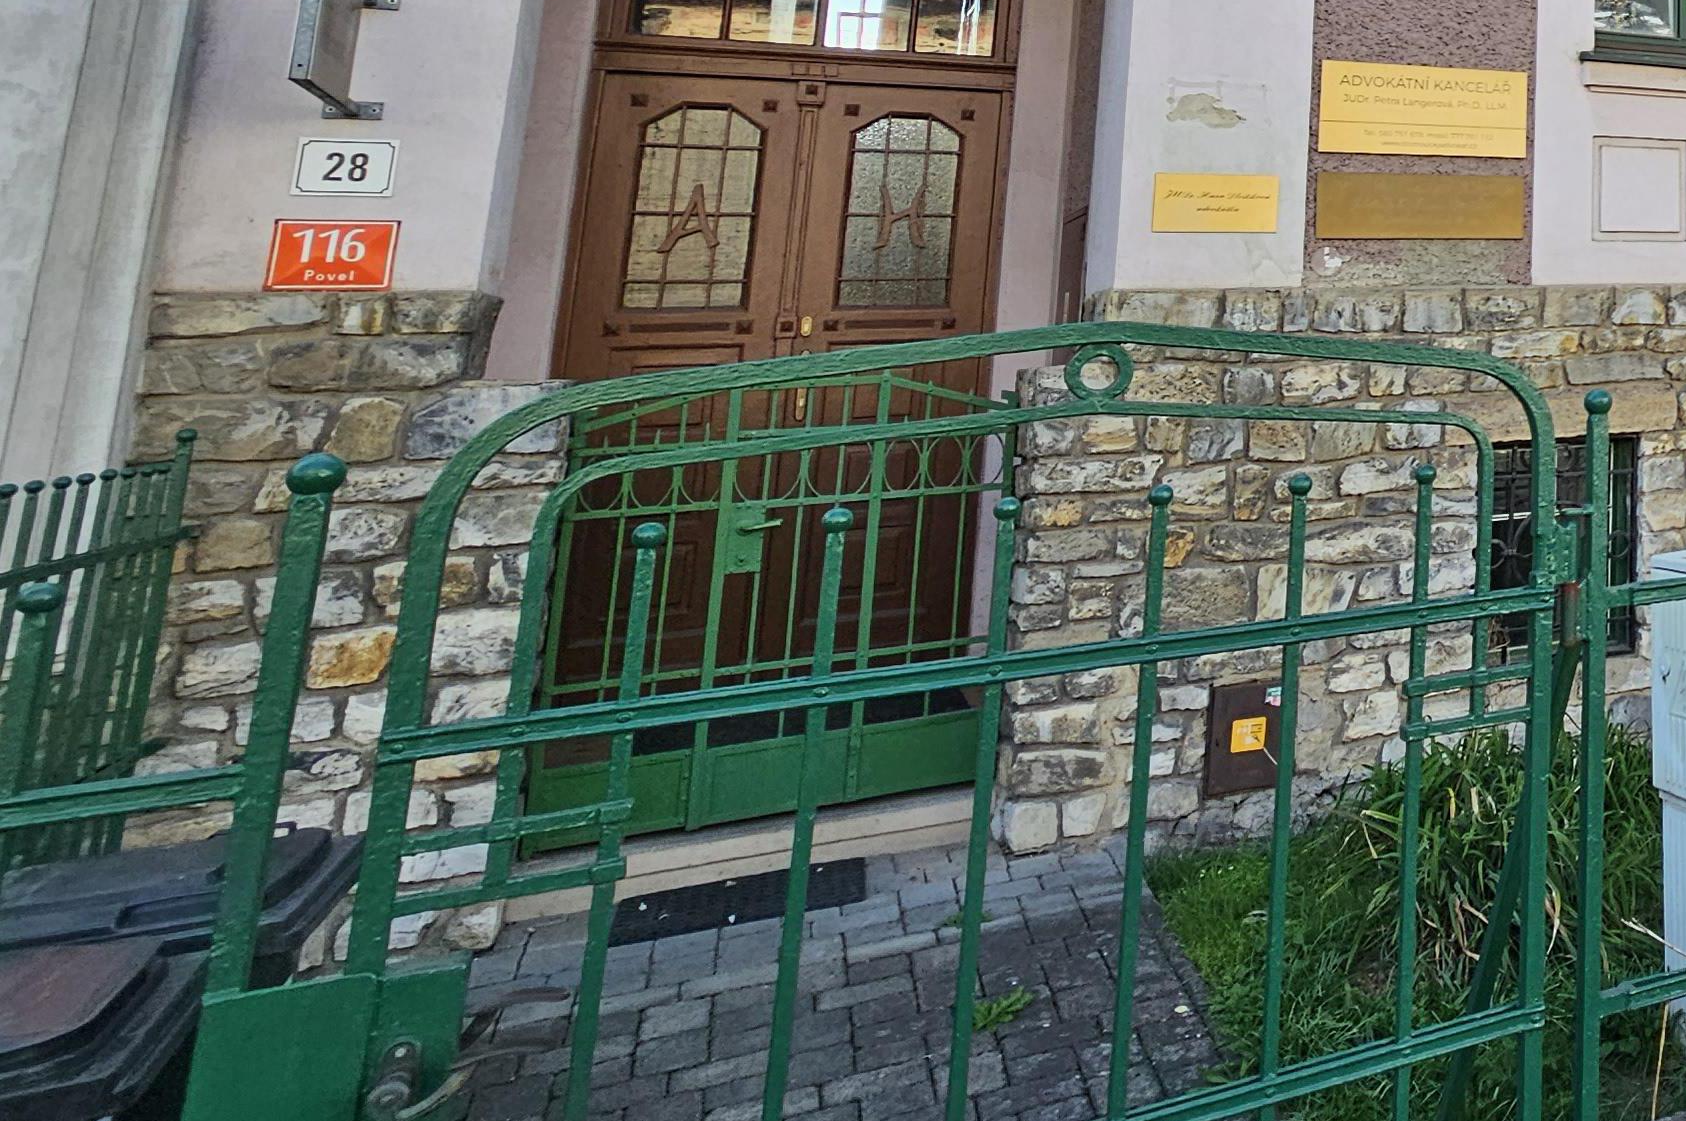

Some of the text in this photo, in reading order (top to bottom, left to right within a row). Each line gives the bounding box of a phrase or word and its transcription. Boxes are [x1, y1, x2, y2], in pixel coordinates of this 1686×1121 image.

[1339, 74, 1512, 95] ADVOKÁTNÍ KANCELÁŘ
[1374, 96, 1400, 105] Petra
[322, 152, 369, 182] 28
[292, 229, 366, 263] 116
[303, 269, 355, 281] Povel
